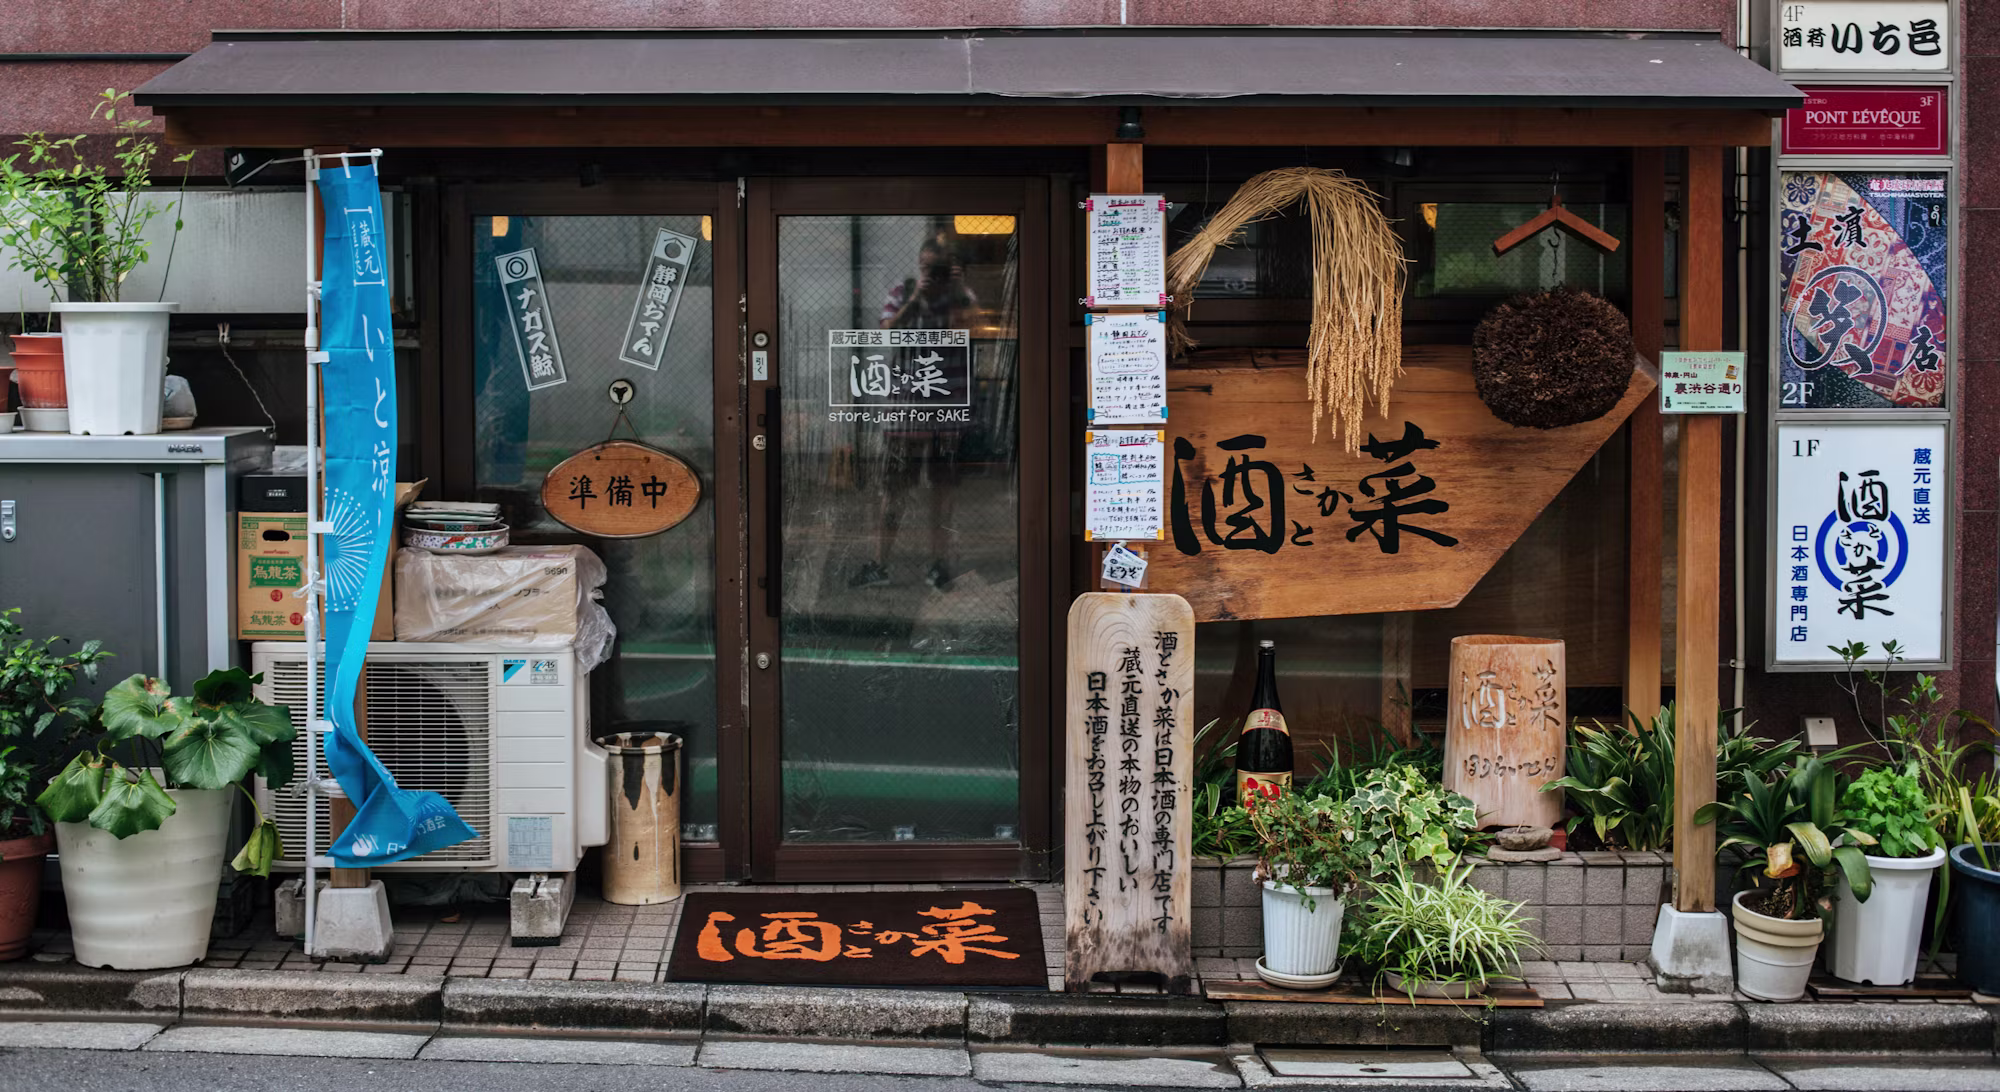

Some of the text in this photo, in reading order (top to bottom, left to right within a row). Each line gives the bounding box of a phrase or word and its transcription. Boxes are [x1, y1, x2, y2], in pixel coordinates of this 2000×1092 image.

[1784, 5, 1805, 21] 4F
[1831, 19, 1941, 56] いち邑
[1919, 96, 1934, 107] 3F
[1805, 110, 1848, 124] PONT
[517, 287, 555, 379] ナガス鯨
[831, 331, 966, 344] 蔵元直送 日本酒専門店
[756, 357, 764, 374] 引く
[1674, 382, 1741, 395] 裏渋谷通り
[1782, 382, 1814, 404] 2F
[829, 409, 970, 423] store just for SAKE
[1792, 439, 1820, 457] 1F
[568, 474, 667, 509] 準備中
[1913, 448, 1932, 524] 蔵元直送
[253, 566, 299, 580] 烏龍茶
[1106, 566, 1142, 579] どうぞ
[1790, 525, 1809, 642] 日本酒専門店
[250, 615, 286, 626] 烏龍茶
[1116, 646, 1144, 892] 蔵元直送の本物のおいしい
[1151, 631, 1180, 934] 酒とさか菜は日本酒の専門店です
[1084, 671, 1110, 925] 日本酒をお召し上がり下さい
